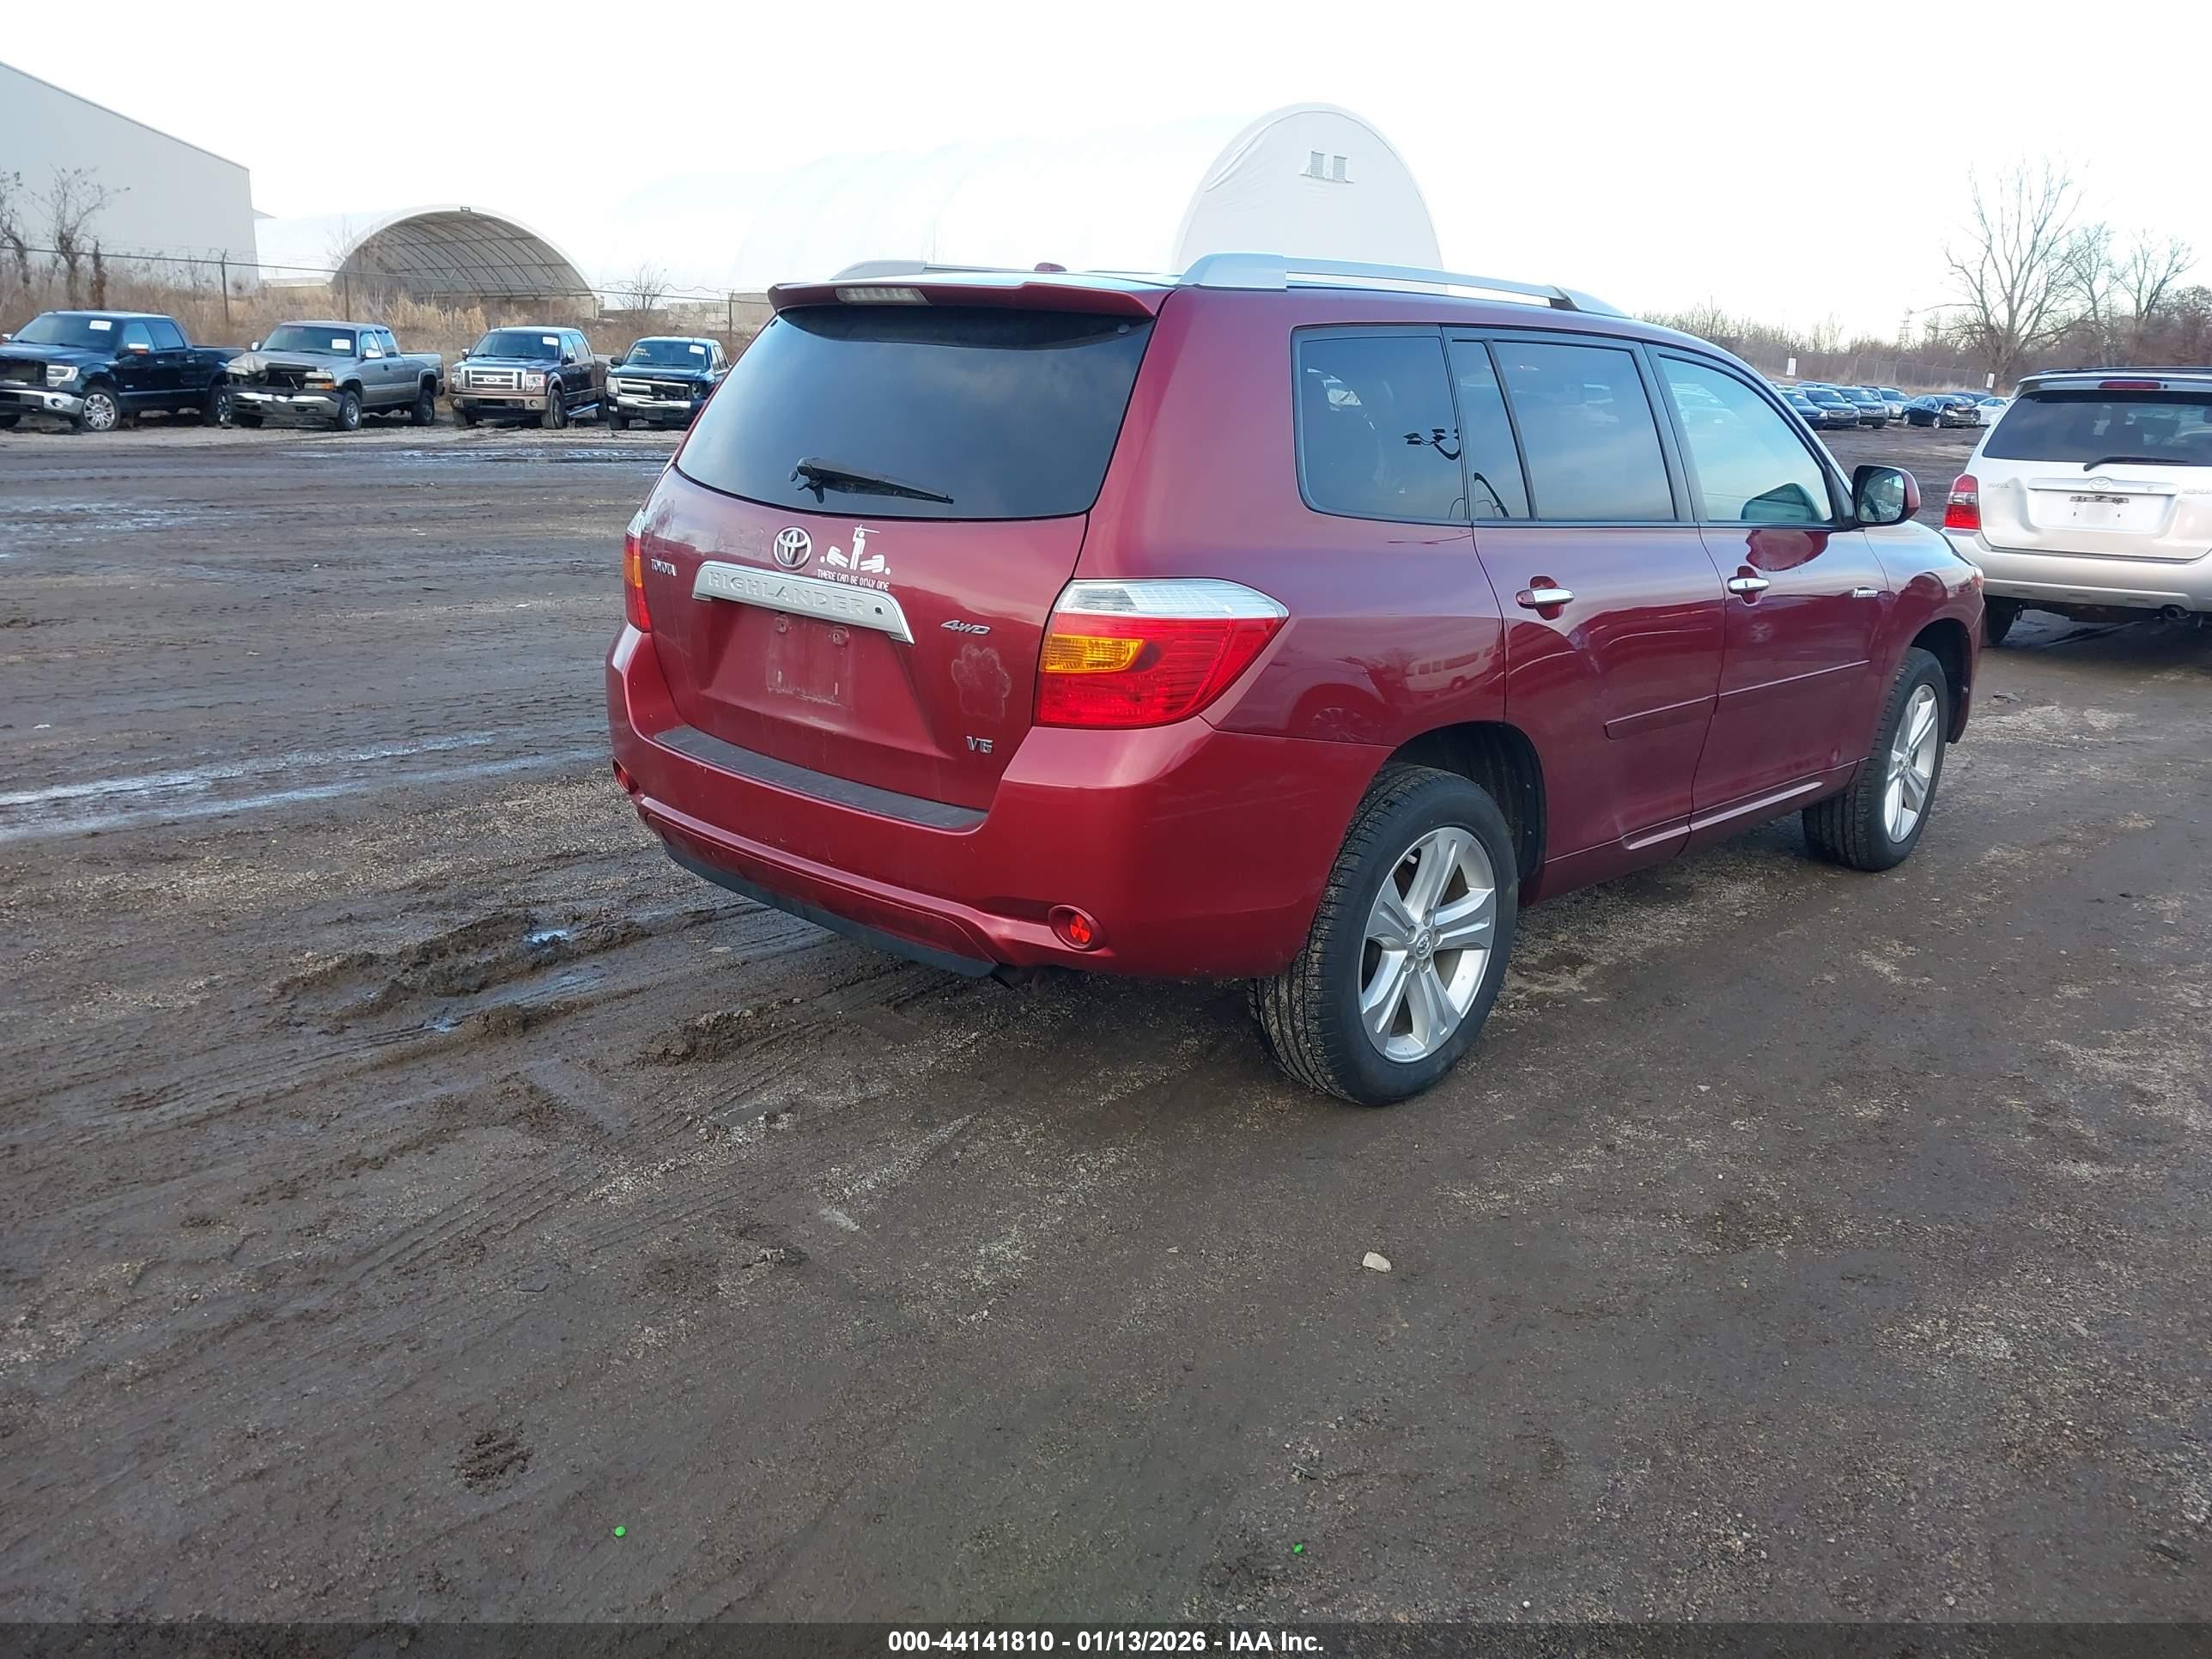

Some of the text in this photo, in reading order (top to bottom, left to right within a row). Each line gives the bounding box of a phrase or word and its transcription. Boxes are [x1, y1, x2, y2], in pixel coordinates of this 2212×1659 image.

[650, 558, 677, 576] TOYOTA
[817, 568, 890, 592] THERE CAN BE ONLY ONE
[708, 571, 866, 616] HIGHLANDER
[941, 620, 990, 635] 4WD
[966, 735, 994, 754] V6
